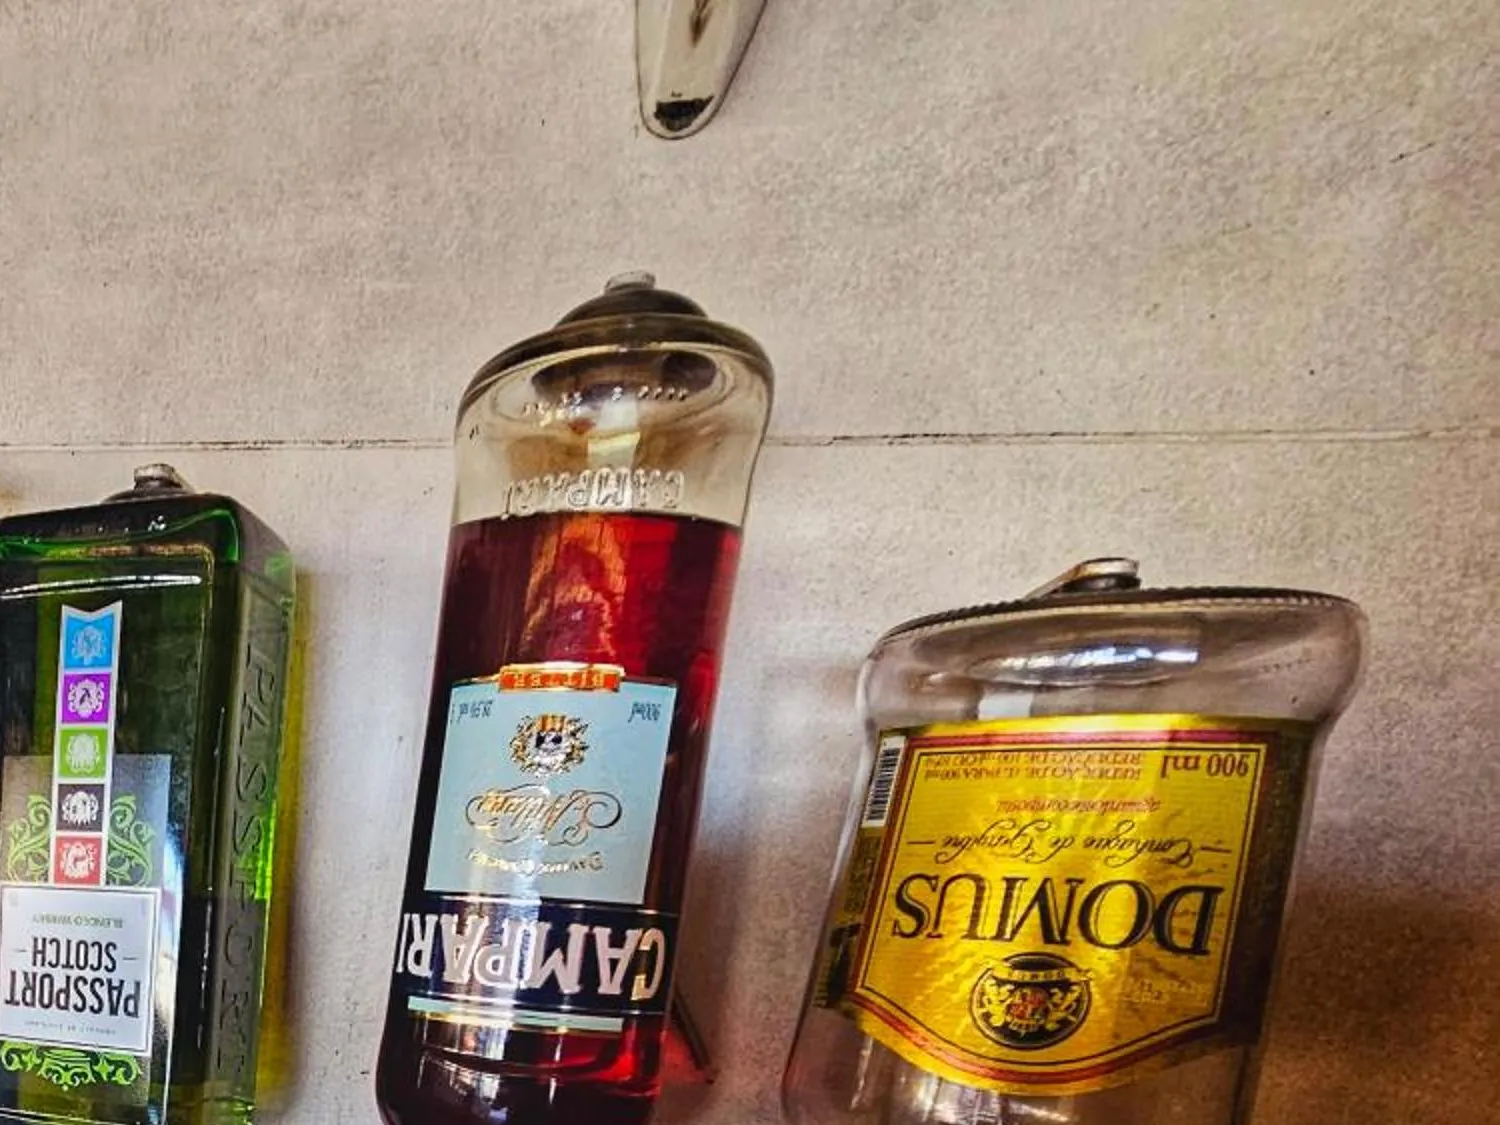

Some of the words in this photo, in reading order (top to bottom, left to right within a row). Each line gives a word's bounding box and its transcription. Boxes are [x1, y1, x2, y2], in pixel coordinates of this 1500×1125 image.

[1160, 754, 1202, 779] ml
[1206, 753, 1250, 778] 900
[934, 819, 1052, 865] Gengibre
[1044, 836, 1075, 865] de
[1083, 821, 1195, 868] Conhaque
[893, 873, 1224, 956] DOMUS
[31, 937, 118, 973] SCOTCH
[396, 910, 667, 1001] CAMPARI
[4, 969, 142, 1019] PASSPORT
